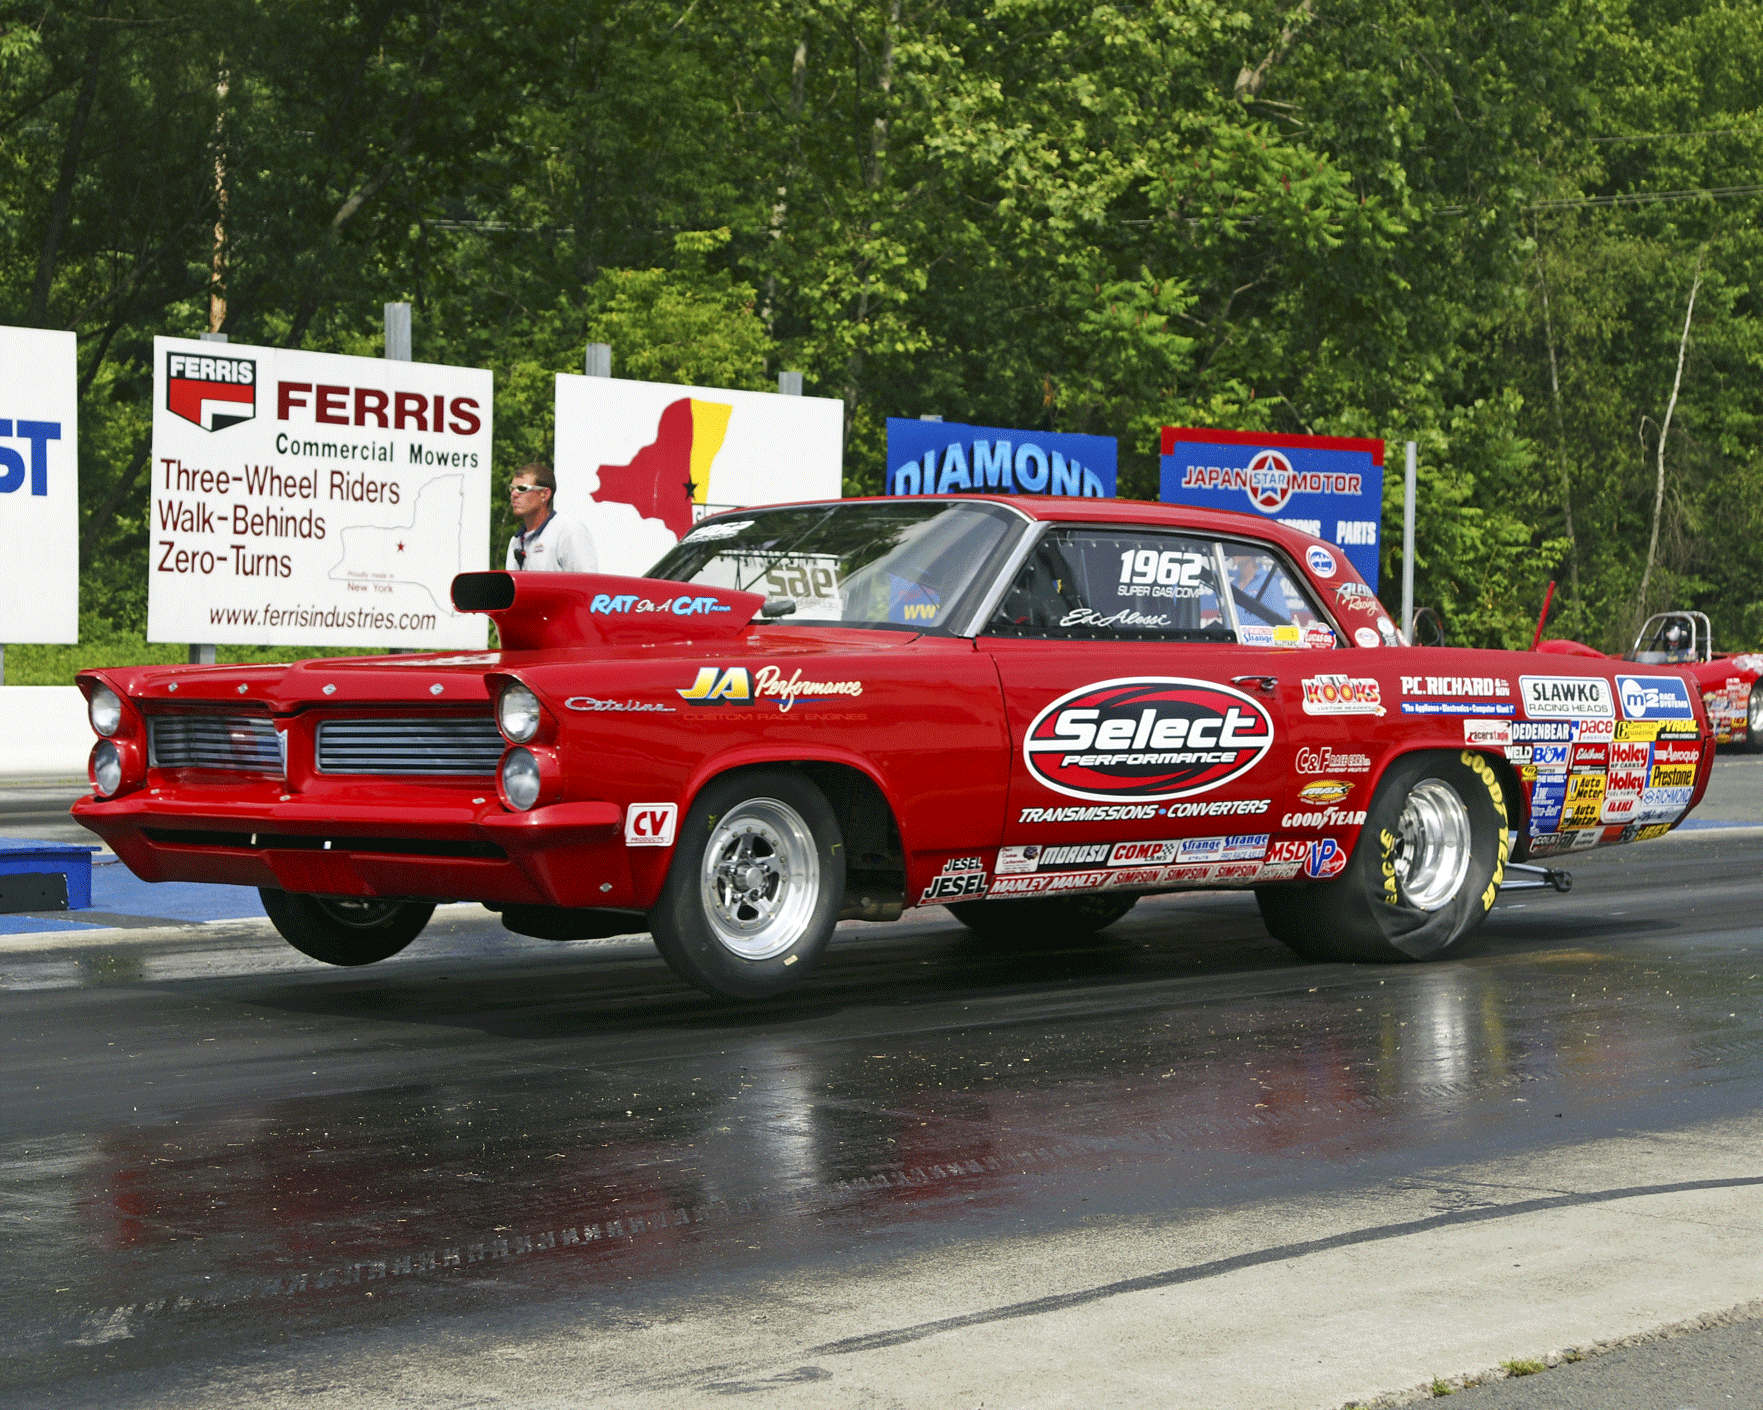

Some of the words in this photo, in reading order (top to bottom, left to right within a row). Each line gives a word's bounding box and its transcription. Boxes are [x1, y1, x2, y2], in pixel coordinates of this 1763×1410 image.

[170, 355, 253, 384] FERRIS
[277, 381, 481, 435] FERRIS
[276, 432, 394, 462] Commercial
[409, 443, 479, 468] Mowers
[895, 440, 1105, 498] DIAMOND
[160, 458, 317, 499] Three-Wheel
[329, 470, 400, 504] Riders
[1182, 466, 1248, 490] JAPAN
[1253, 472, 1286, 485] STAR
[1290, 472, 1362, 496] MOTOR
[158, 499, 326, 540] Walk-Behinds
[1336, 520, 1377, 545] PARTS
[157, 540, 292, 578] Zero-Turns
[1119, 549, 1203, 587] 1962
[347, 582, 368, 592] New
[373, 582, 393, 594] York
[1117, 586, 1151, 597] SUPER
[590, 593, 640, 616] RAT
[209, 604, 436, 630] www.ferrisindustries.com
[675, 667, 754, 706] JA
[754, 665, 864, 713] Performance
[1305, 681, 1379, 703] KOOKS
[1425, 676, 1494, 696] RICHARD
[1533, 683, 1600, 701] SLAWKO
[564, 696, 677, 712] Catalina
[1529, 703, 1571, 712] RACING
[1572, 703, 1609, 713] HEADS
[683, 713, 753, 721] CUSTOM
[757, 713, 799, 721] RACE
[804, 713, 868, 721] ENGINES
[1657, 720, 1700, 732] PYROIL
[1052, 708, 1257, 751] Select
[1512, 723, 1570, 740] DEDENBEAR
[1579, 720, 1613, 741] pace
[1061, 752, 1238, 767] PERFORMANCE
[1295, 747, 1332, 773] C&F
[1504, 745, 1533, 760] WELD
[1612, 744, 1648, 768] Holley
[1580, 777, 1601, 788] Auto
[1607, 772, 1645, 796] Holley
[1652, 765, 1692, 786] Prestone
[1577, 788, 1603, 799] Meter
[1018, 804, 1159, 823] TRANSMISSIONS
[1166, 799, 1272, 818] CONVERTERS
[1281, 806, 1367, 831] GOODYEAR
[1574, 804, 1596, 815] Auto
[633, 810, 669, 836] CV
[1182, 839, 1222, 851] Strange
[1225, 835, 1268, 847] Strange
[1039, 844, 1111, 865] MOROSO
[1113, 843, 1164, 861] COMP
[1266, 841, 1310, 863] MSD
[1309, 838, 1337, 877] VP
[945, 857, 982, 872] JESEL
[1164, 866, 1211, 882] SIMPSON
[1215, 863, 1259, 879] SIMPSON
[924, 872, 987, 898] JESEL
[989, 877, 1050, 894] MANLEY
[1050, 872, 1108, 890] MANLEY
[1113, 869, 1162, 884] SIMPSON
